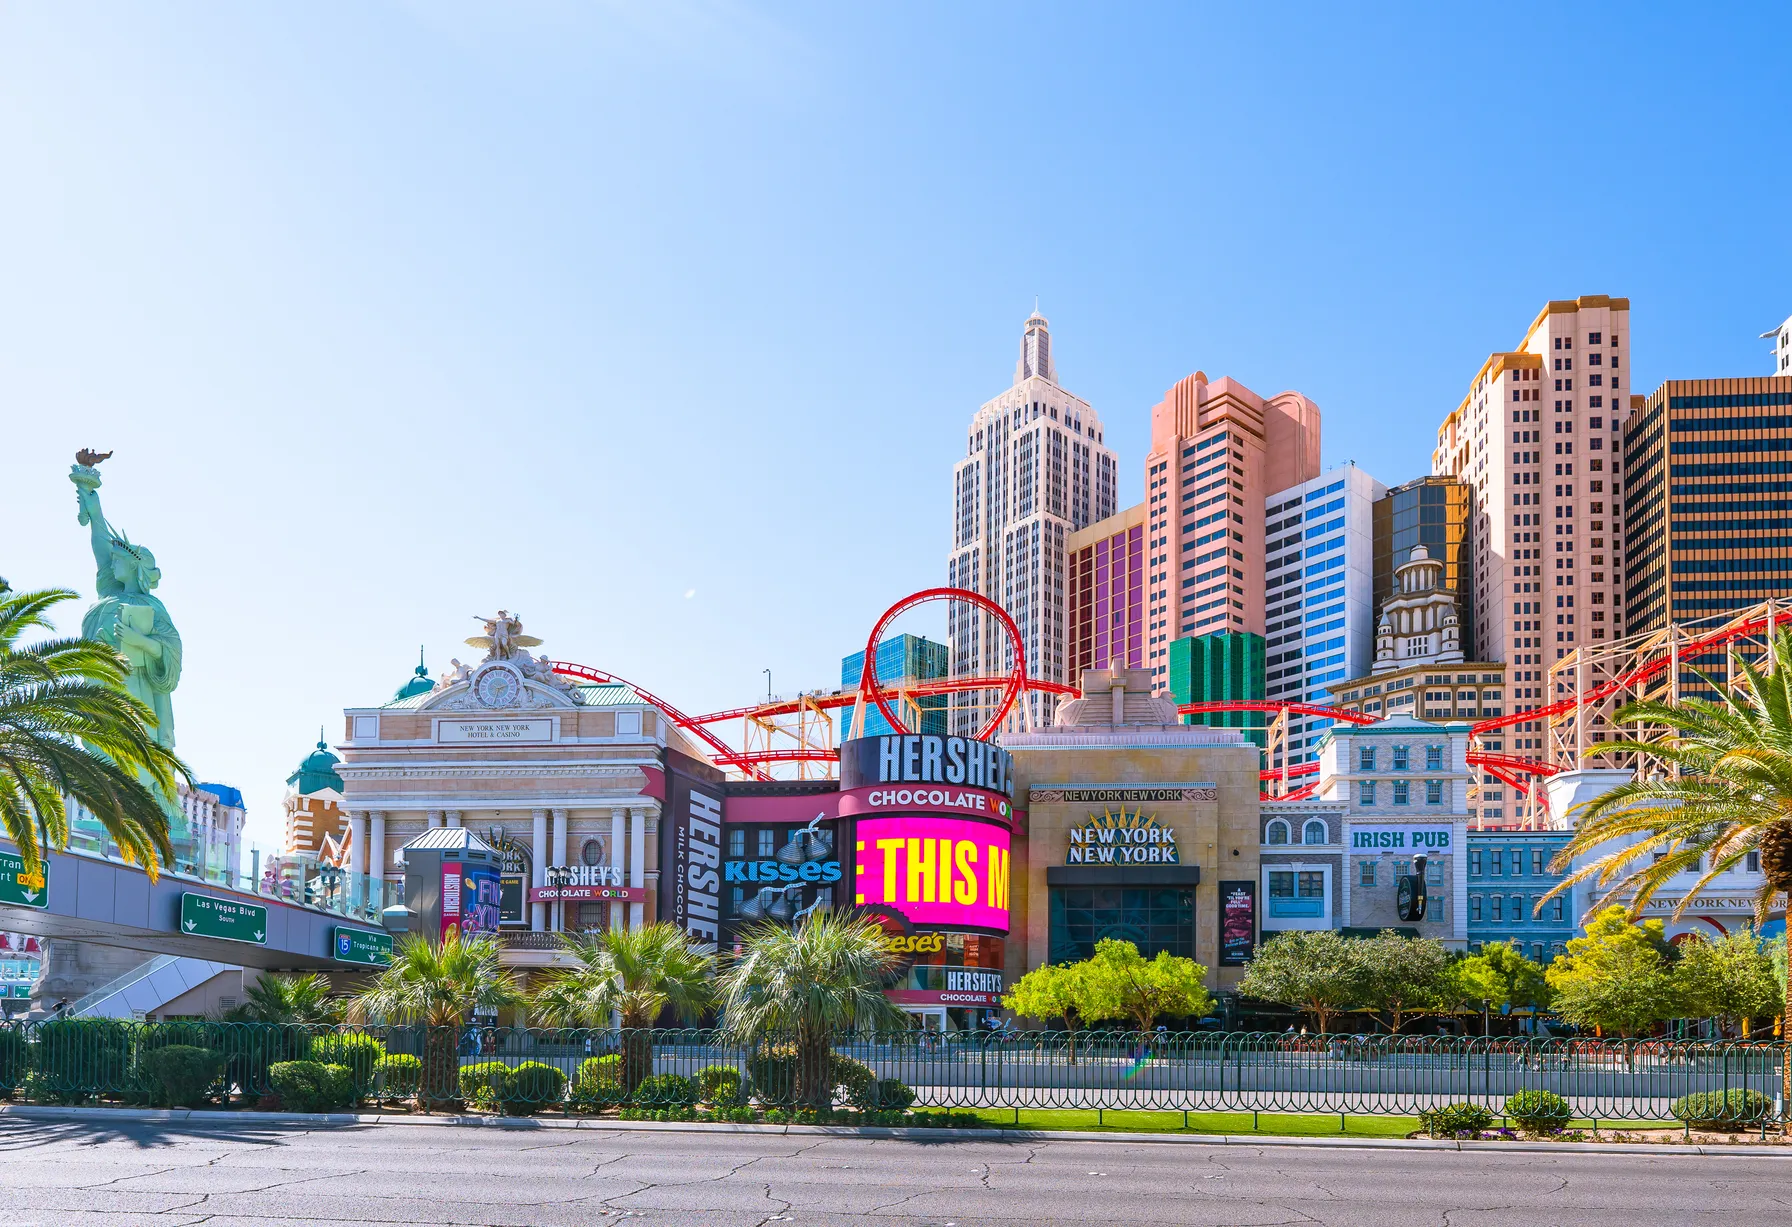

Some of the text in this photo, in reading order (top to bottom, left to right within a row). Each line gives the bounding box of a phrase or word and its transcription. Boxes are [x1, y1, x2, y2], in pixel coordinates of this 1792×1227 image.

[868, 790, 985, 810] CHOCOLATE
[1070, 828, 1175, 843] NEW YORK
[1353, 832, 1450, 847] IRISH PUB
[500, 851, 521, 860] ORK
[1070, 847, 1176, 862] NEW YORK
[500, 862, 521, 871] ORK
[876, 838, 978, 906] THIS
[479, 879, 500, 907] FIN
[594, 890, 628, 898] WORLD
[196, 899, 256, 917] Las Vegas Blvd
[341, 940, 349, 950] 15
[353, 941, 379, 951] Tropicana
[940, 994, 986, 1002] CHOCOLATE
